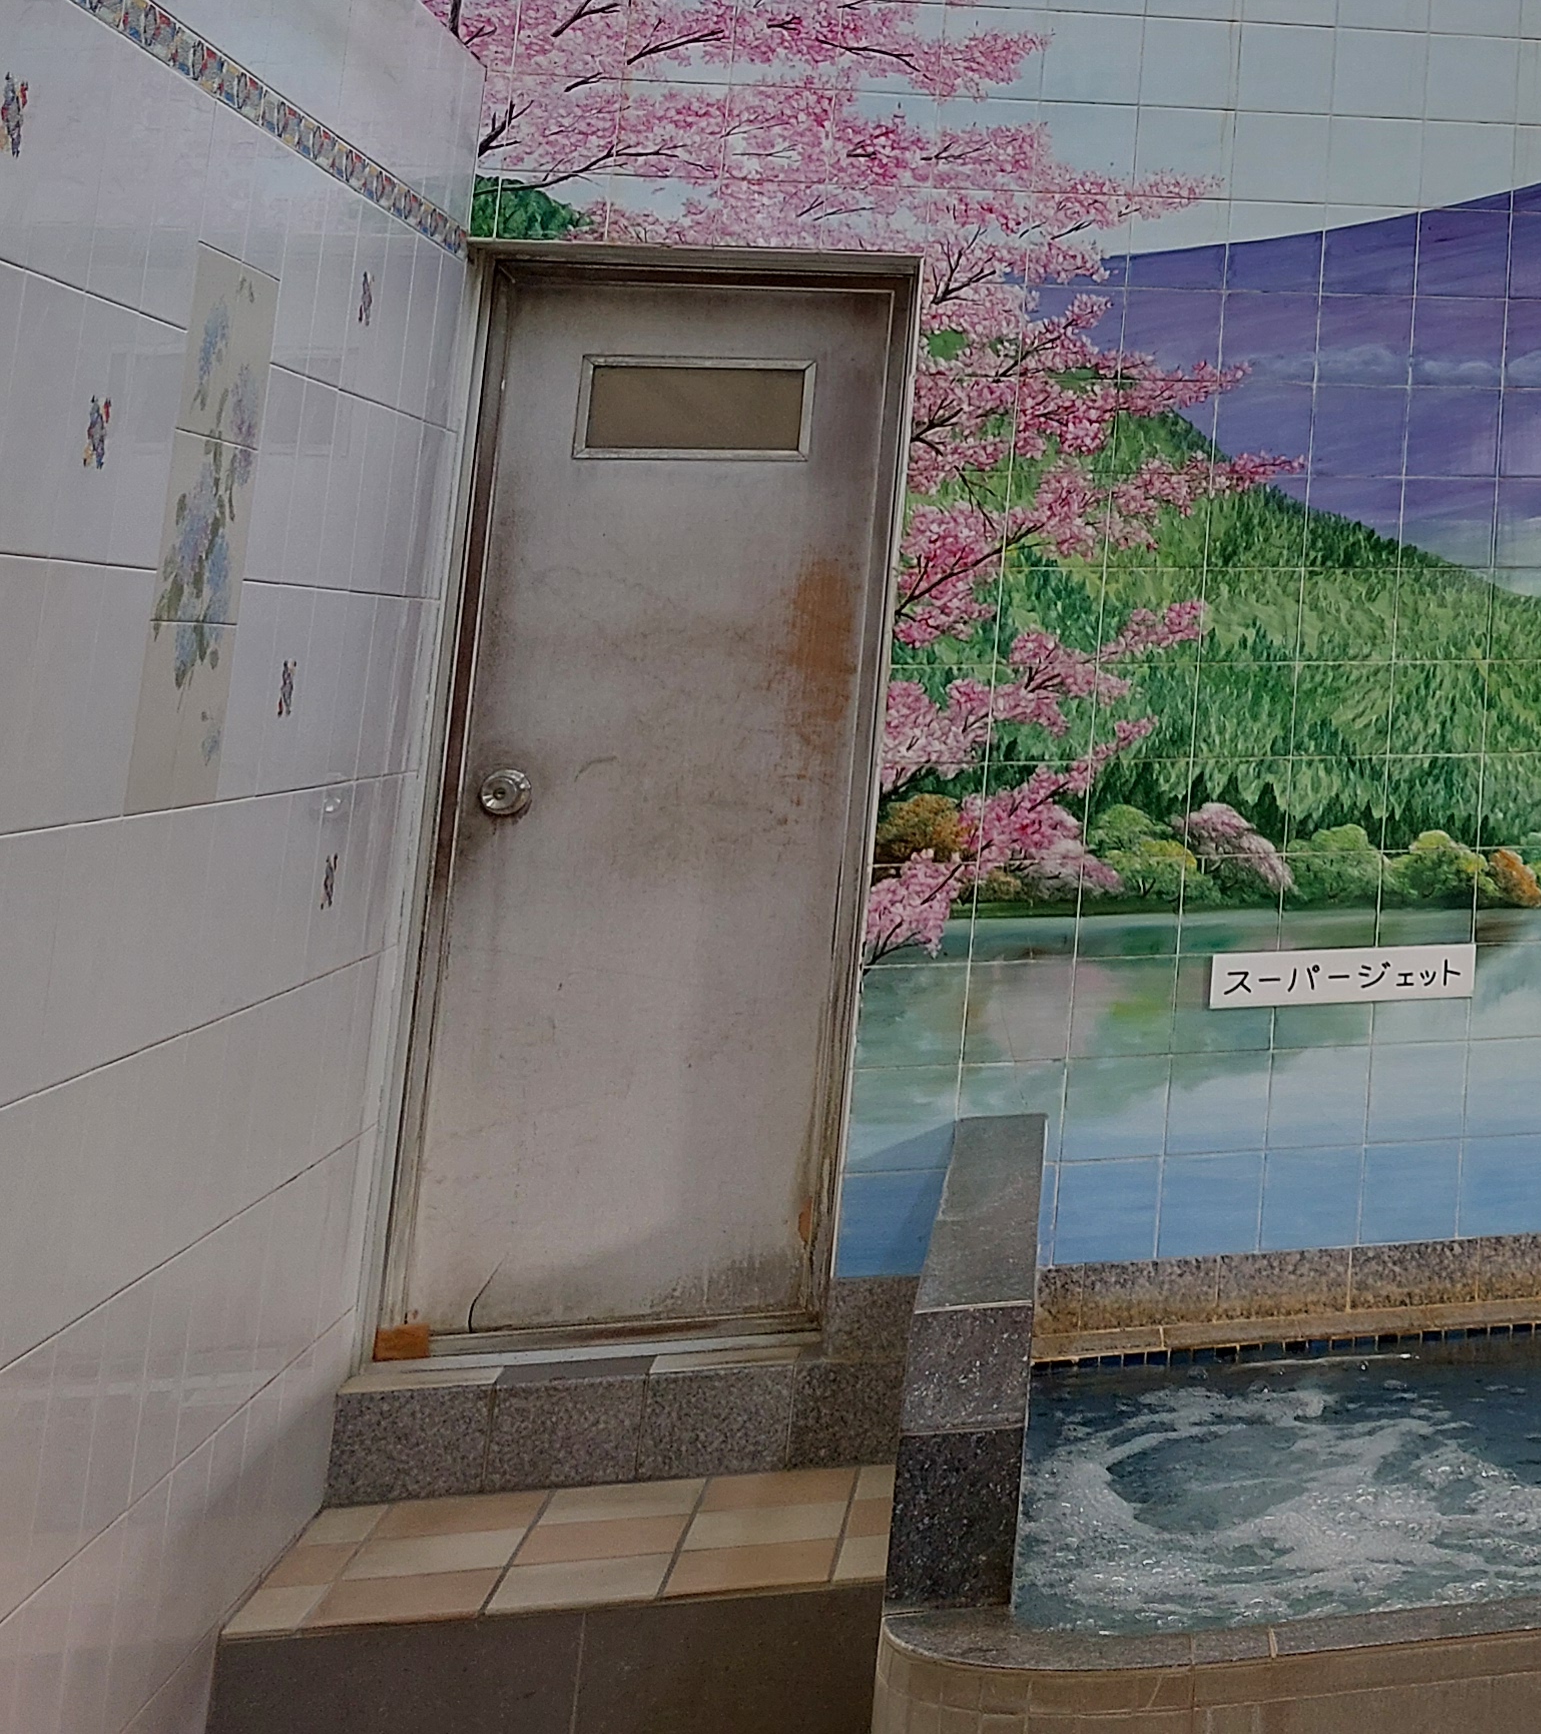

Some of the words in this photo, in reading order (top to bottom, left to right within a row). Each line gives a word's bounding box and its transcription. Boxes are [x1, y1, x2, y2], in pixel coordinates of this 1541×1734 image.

[1223, 958, 1462, 996] スーパージェット
